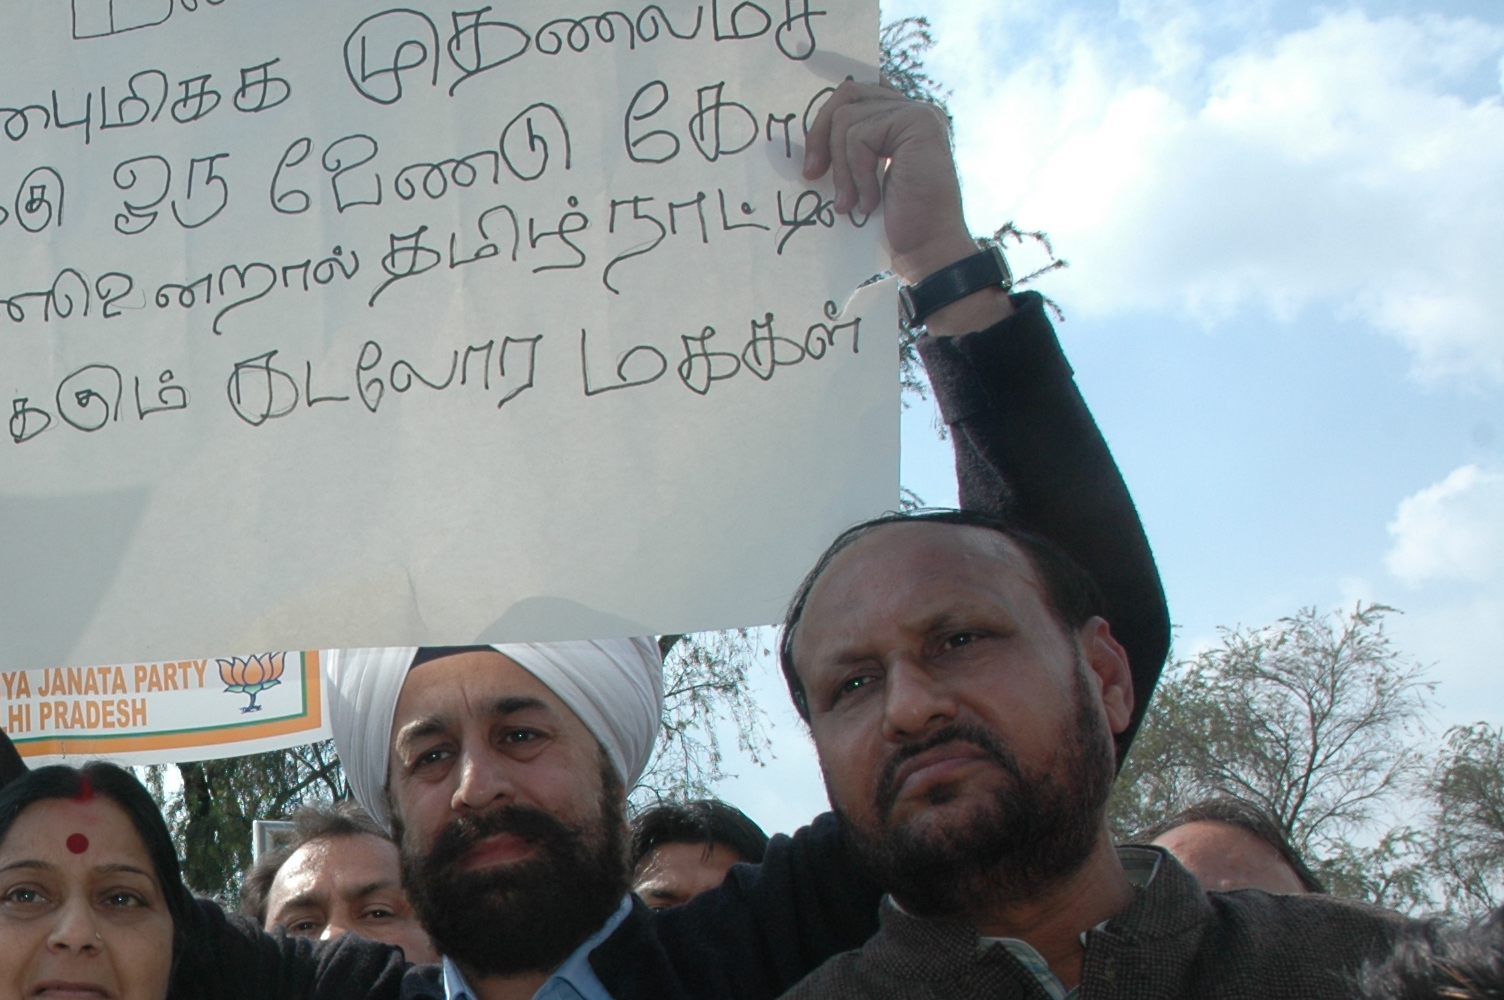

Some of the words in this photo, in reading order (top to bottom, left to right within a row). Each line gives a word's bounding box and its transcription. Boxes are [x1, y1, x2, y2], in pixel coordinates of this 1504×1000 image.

[37, 666, 127, 697] JANATA
[134, 659, 208, 694] PARTY
[39, 698, 148, 731] PRADESH
